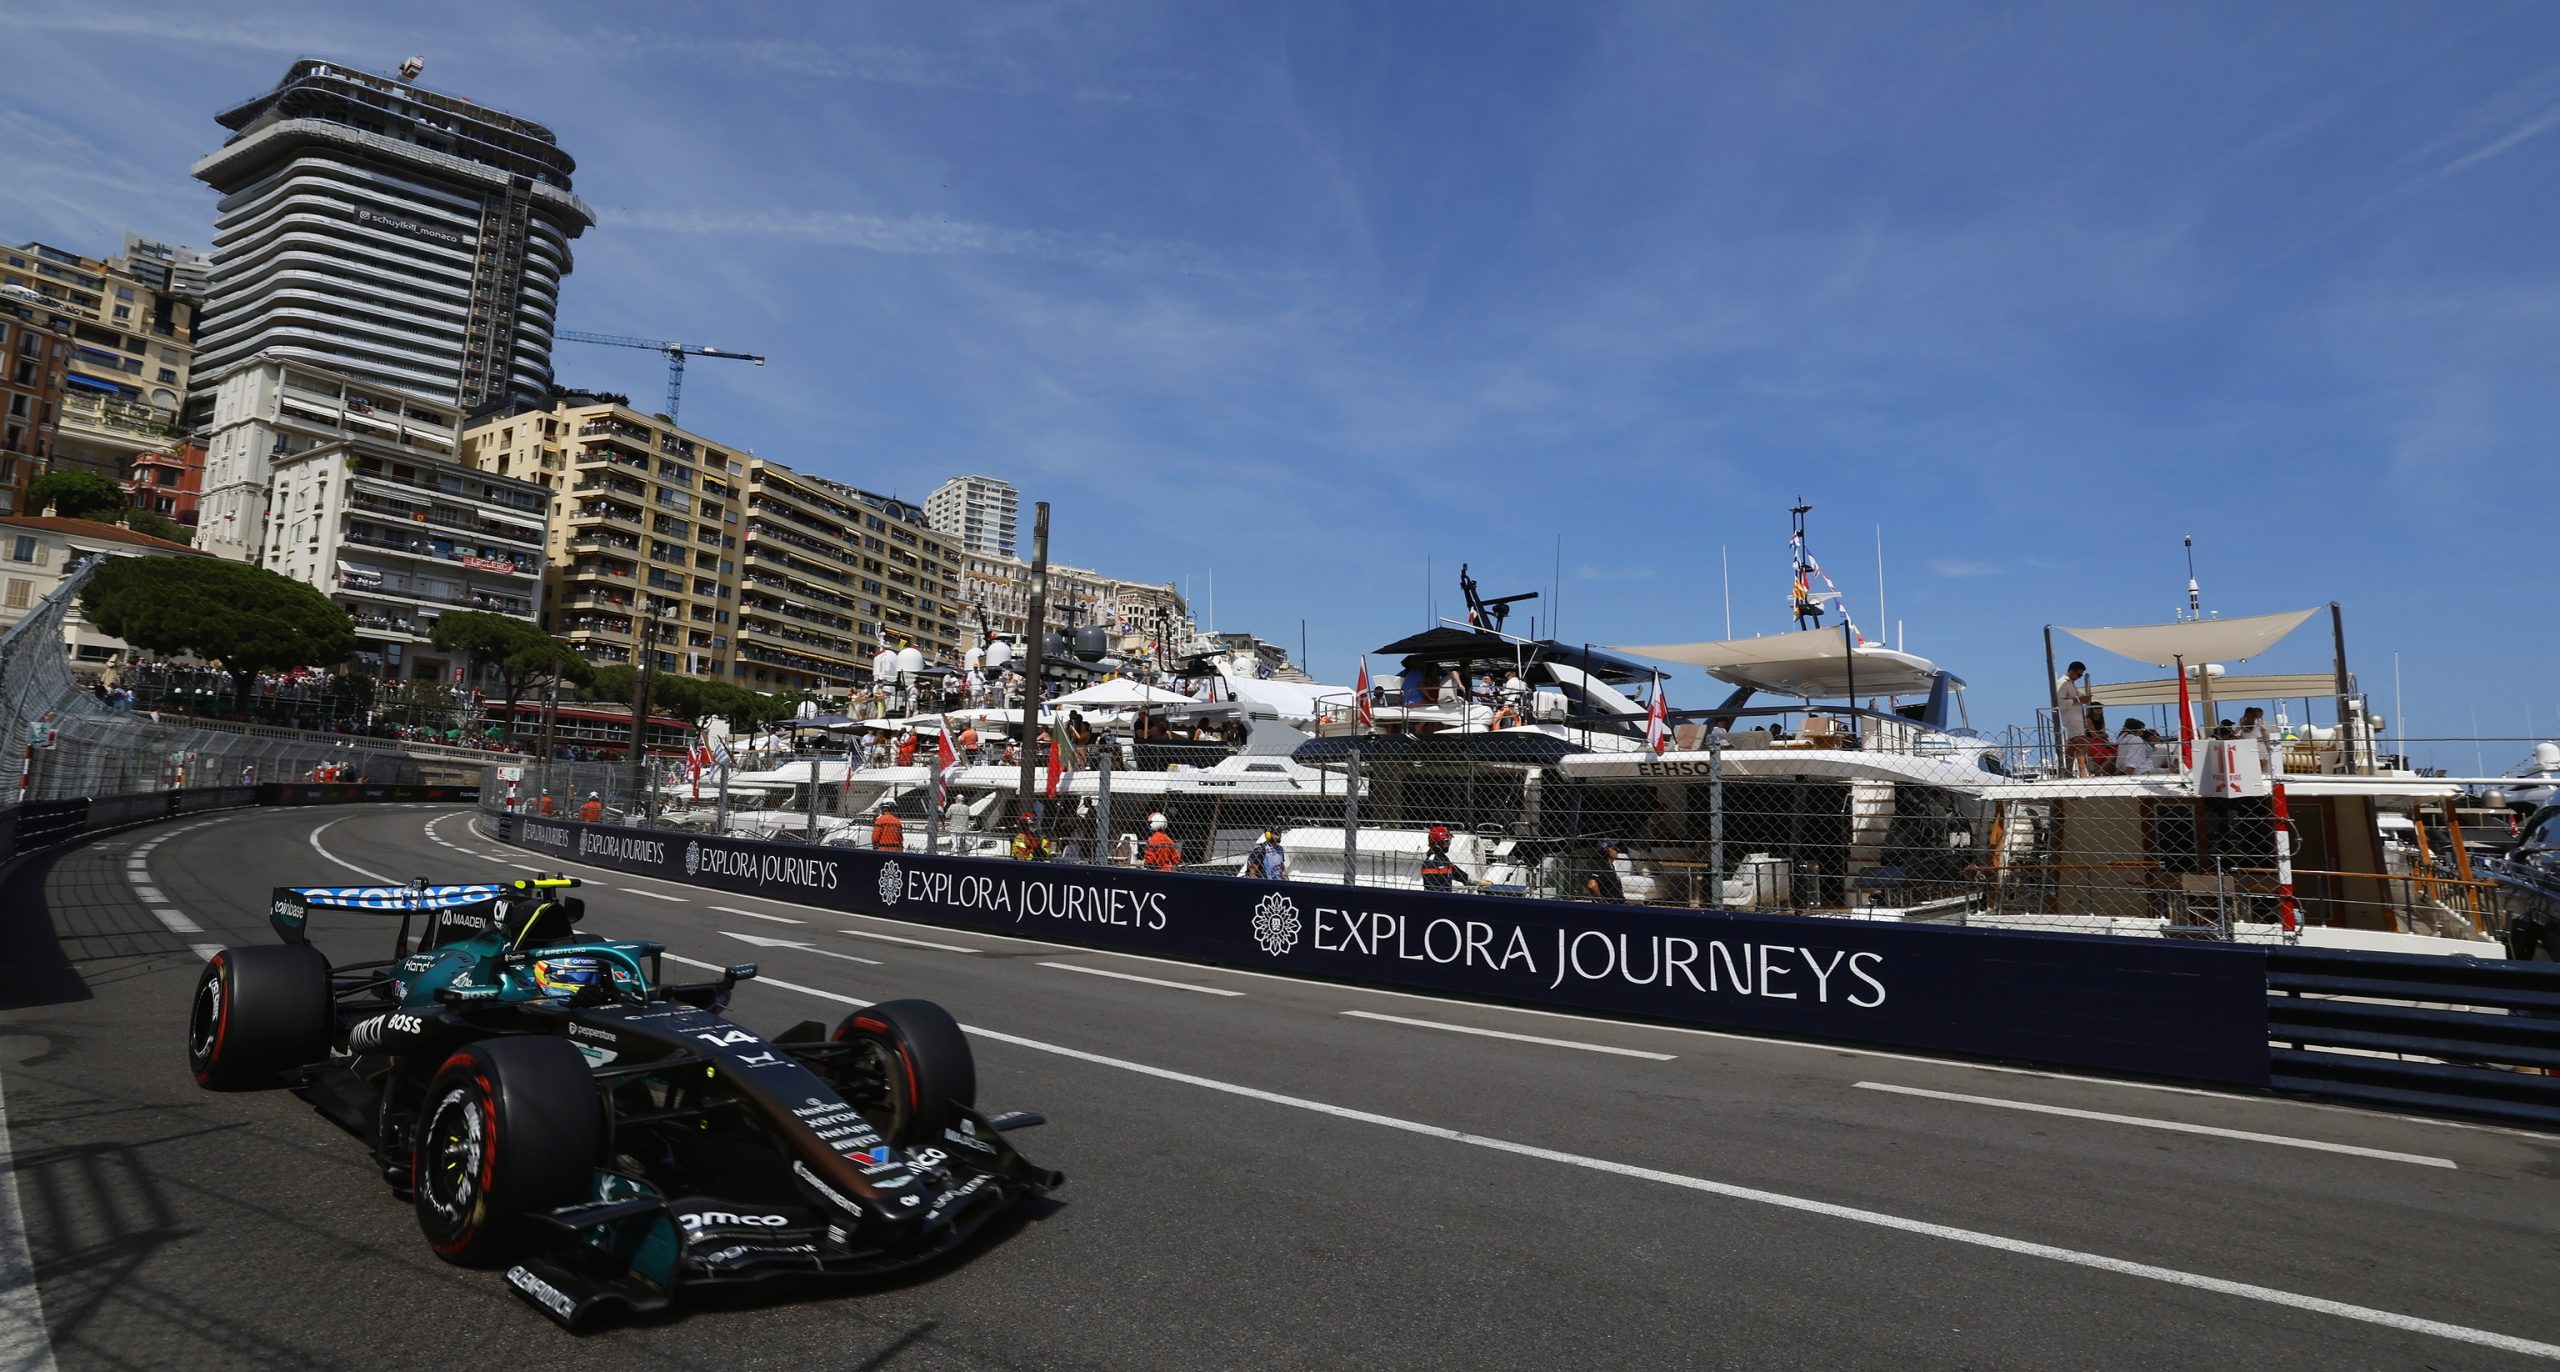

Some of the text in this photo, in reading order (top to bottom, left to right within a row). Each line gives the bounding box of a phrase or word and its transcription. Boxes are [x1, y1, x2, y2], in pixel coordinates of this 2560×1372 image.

[372, 215, 458, 243] schuylkill_monaco
[587, 833, 665, 865] EXPLORA JOURNEYS
[701, 848, 838, 890] EXPLORA JOURNEYS
[907, 870, 1167, 930] EXPLORA JOURNEYS
[274, 898, 305, 920] coinbase
[452, 914, 486, 929] MAADEN
[544, 947, 587, 955] BREITLING
[1315, 908, 1886, 1008] EXPLORA JOURNEYS
[403, 960, 436, 973] Hond
[461, 992, 496, 1000] BOSS
[388, 1013, 423, 1034] BOSS
[577, 1026, 617, 1042] pepperstone
[696, 1030, 760, 1047] 14
[792, 1102, 851, 1118] NexGen
[803, 1111, 862, 1129] xerox
[815, 1123, 874, 1140] NetApp
